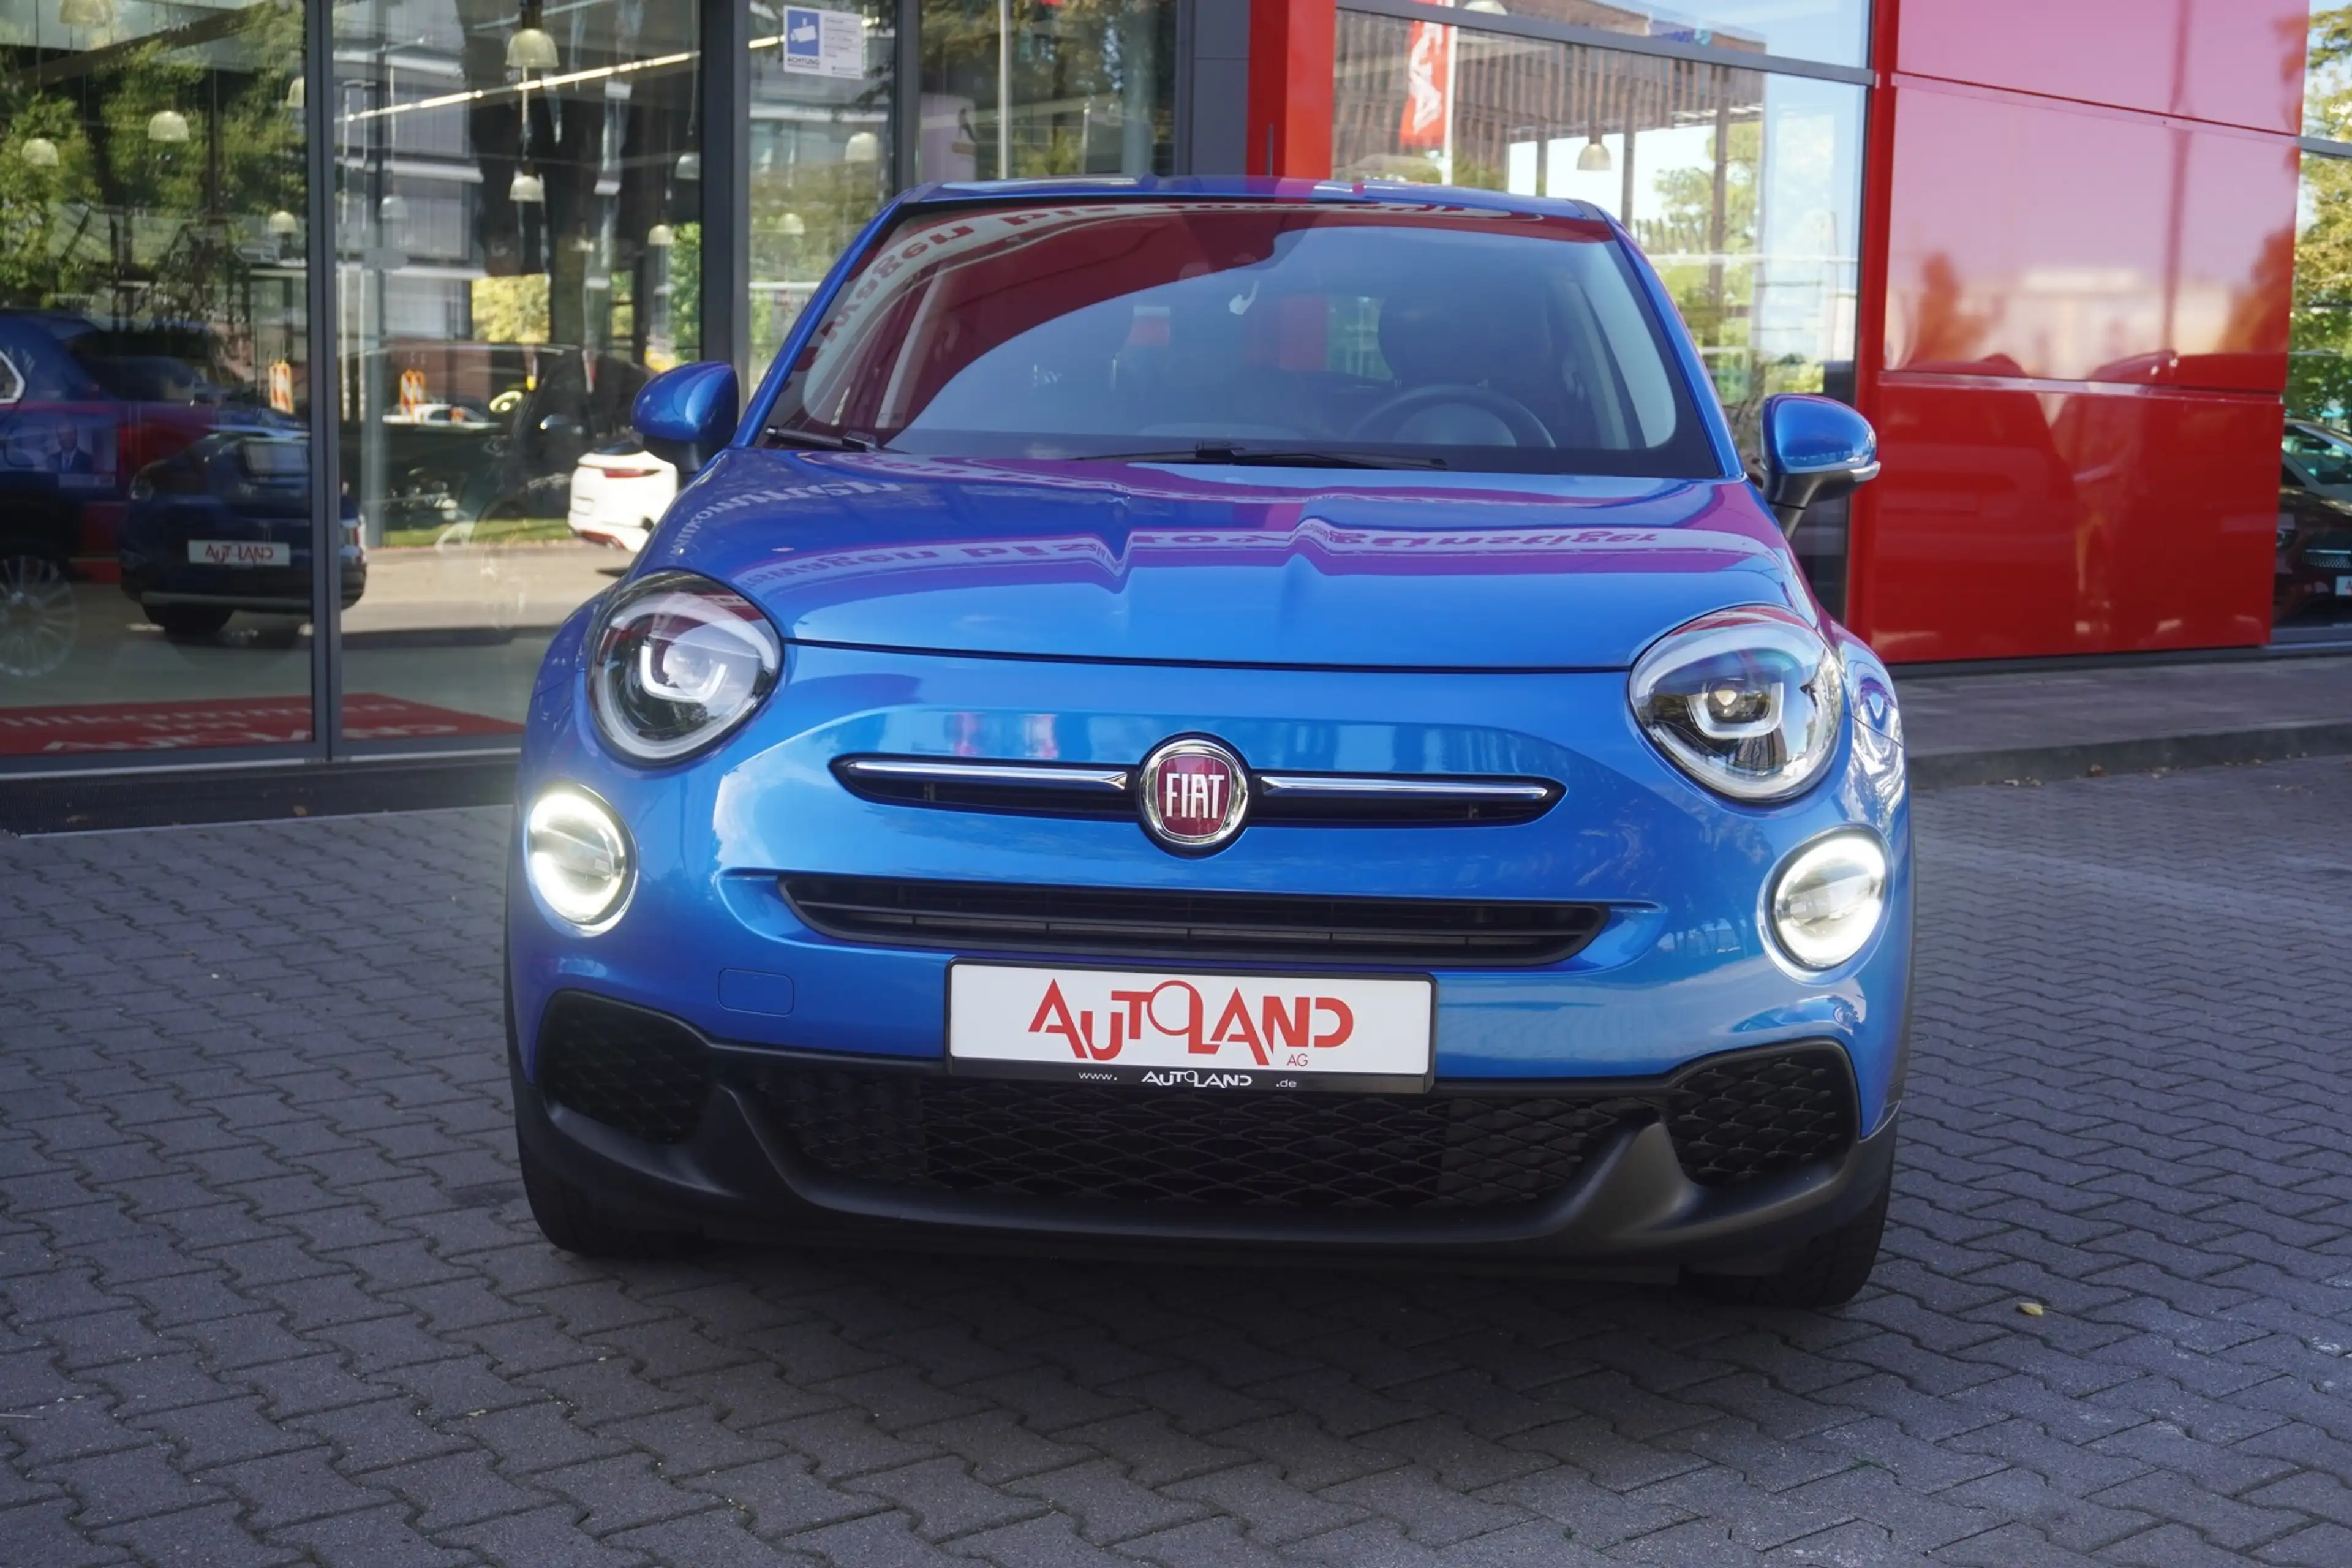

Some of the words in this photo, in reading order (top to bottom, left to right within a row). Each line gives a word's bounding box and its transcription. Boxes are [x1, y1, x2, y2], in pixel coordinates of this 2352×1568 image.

[1166, 772, 1224, 819] FIAT
[1028, 978, 1354, 1066] AUTOLAND
[1287, 1054, 1308, 1067] AG
[1078, 1072, 1117, 1082] www.
[1141, 1070, 1252, 1088] AUTOLAND
[1275, 1078, 1297, 1088] .de
